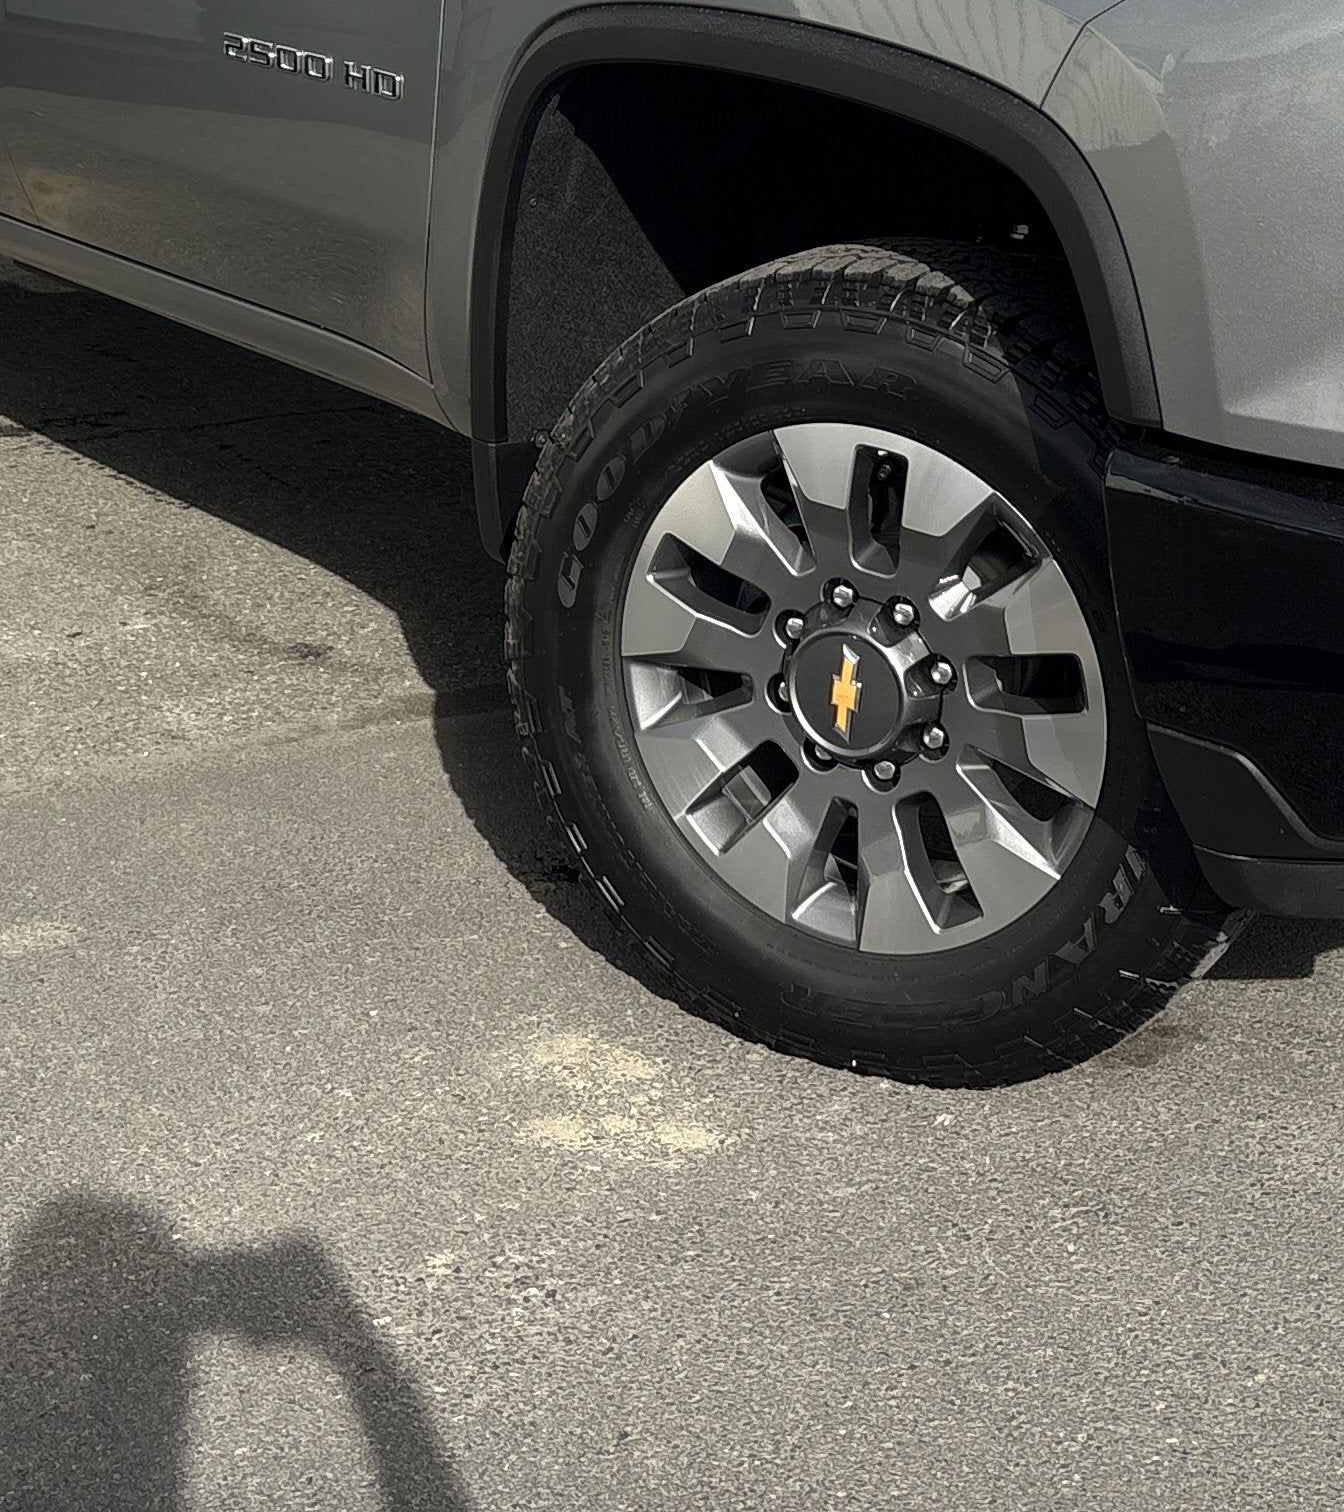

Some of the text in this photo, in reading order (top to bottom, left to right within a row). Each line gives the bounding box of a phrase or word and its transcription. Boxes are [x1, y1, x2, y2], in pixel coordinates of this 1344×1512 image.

[223, 31, 405, 100] 2500 HD
[557, 358, 918, 608] GOODYEAR
